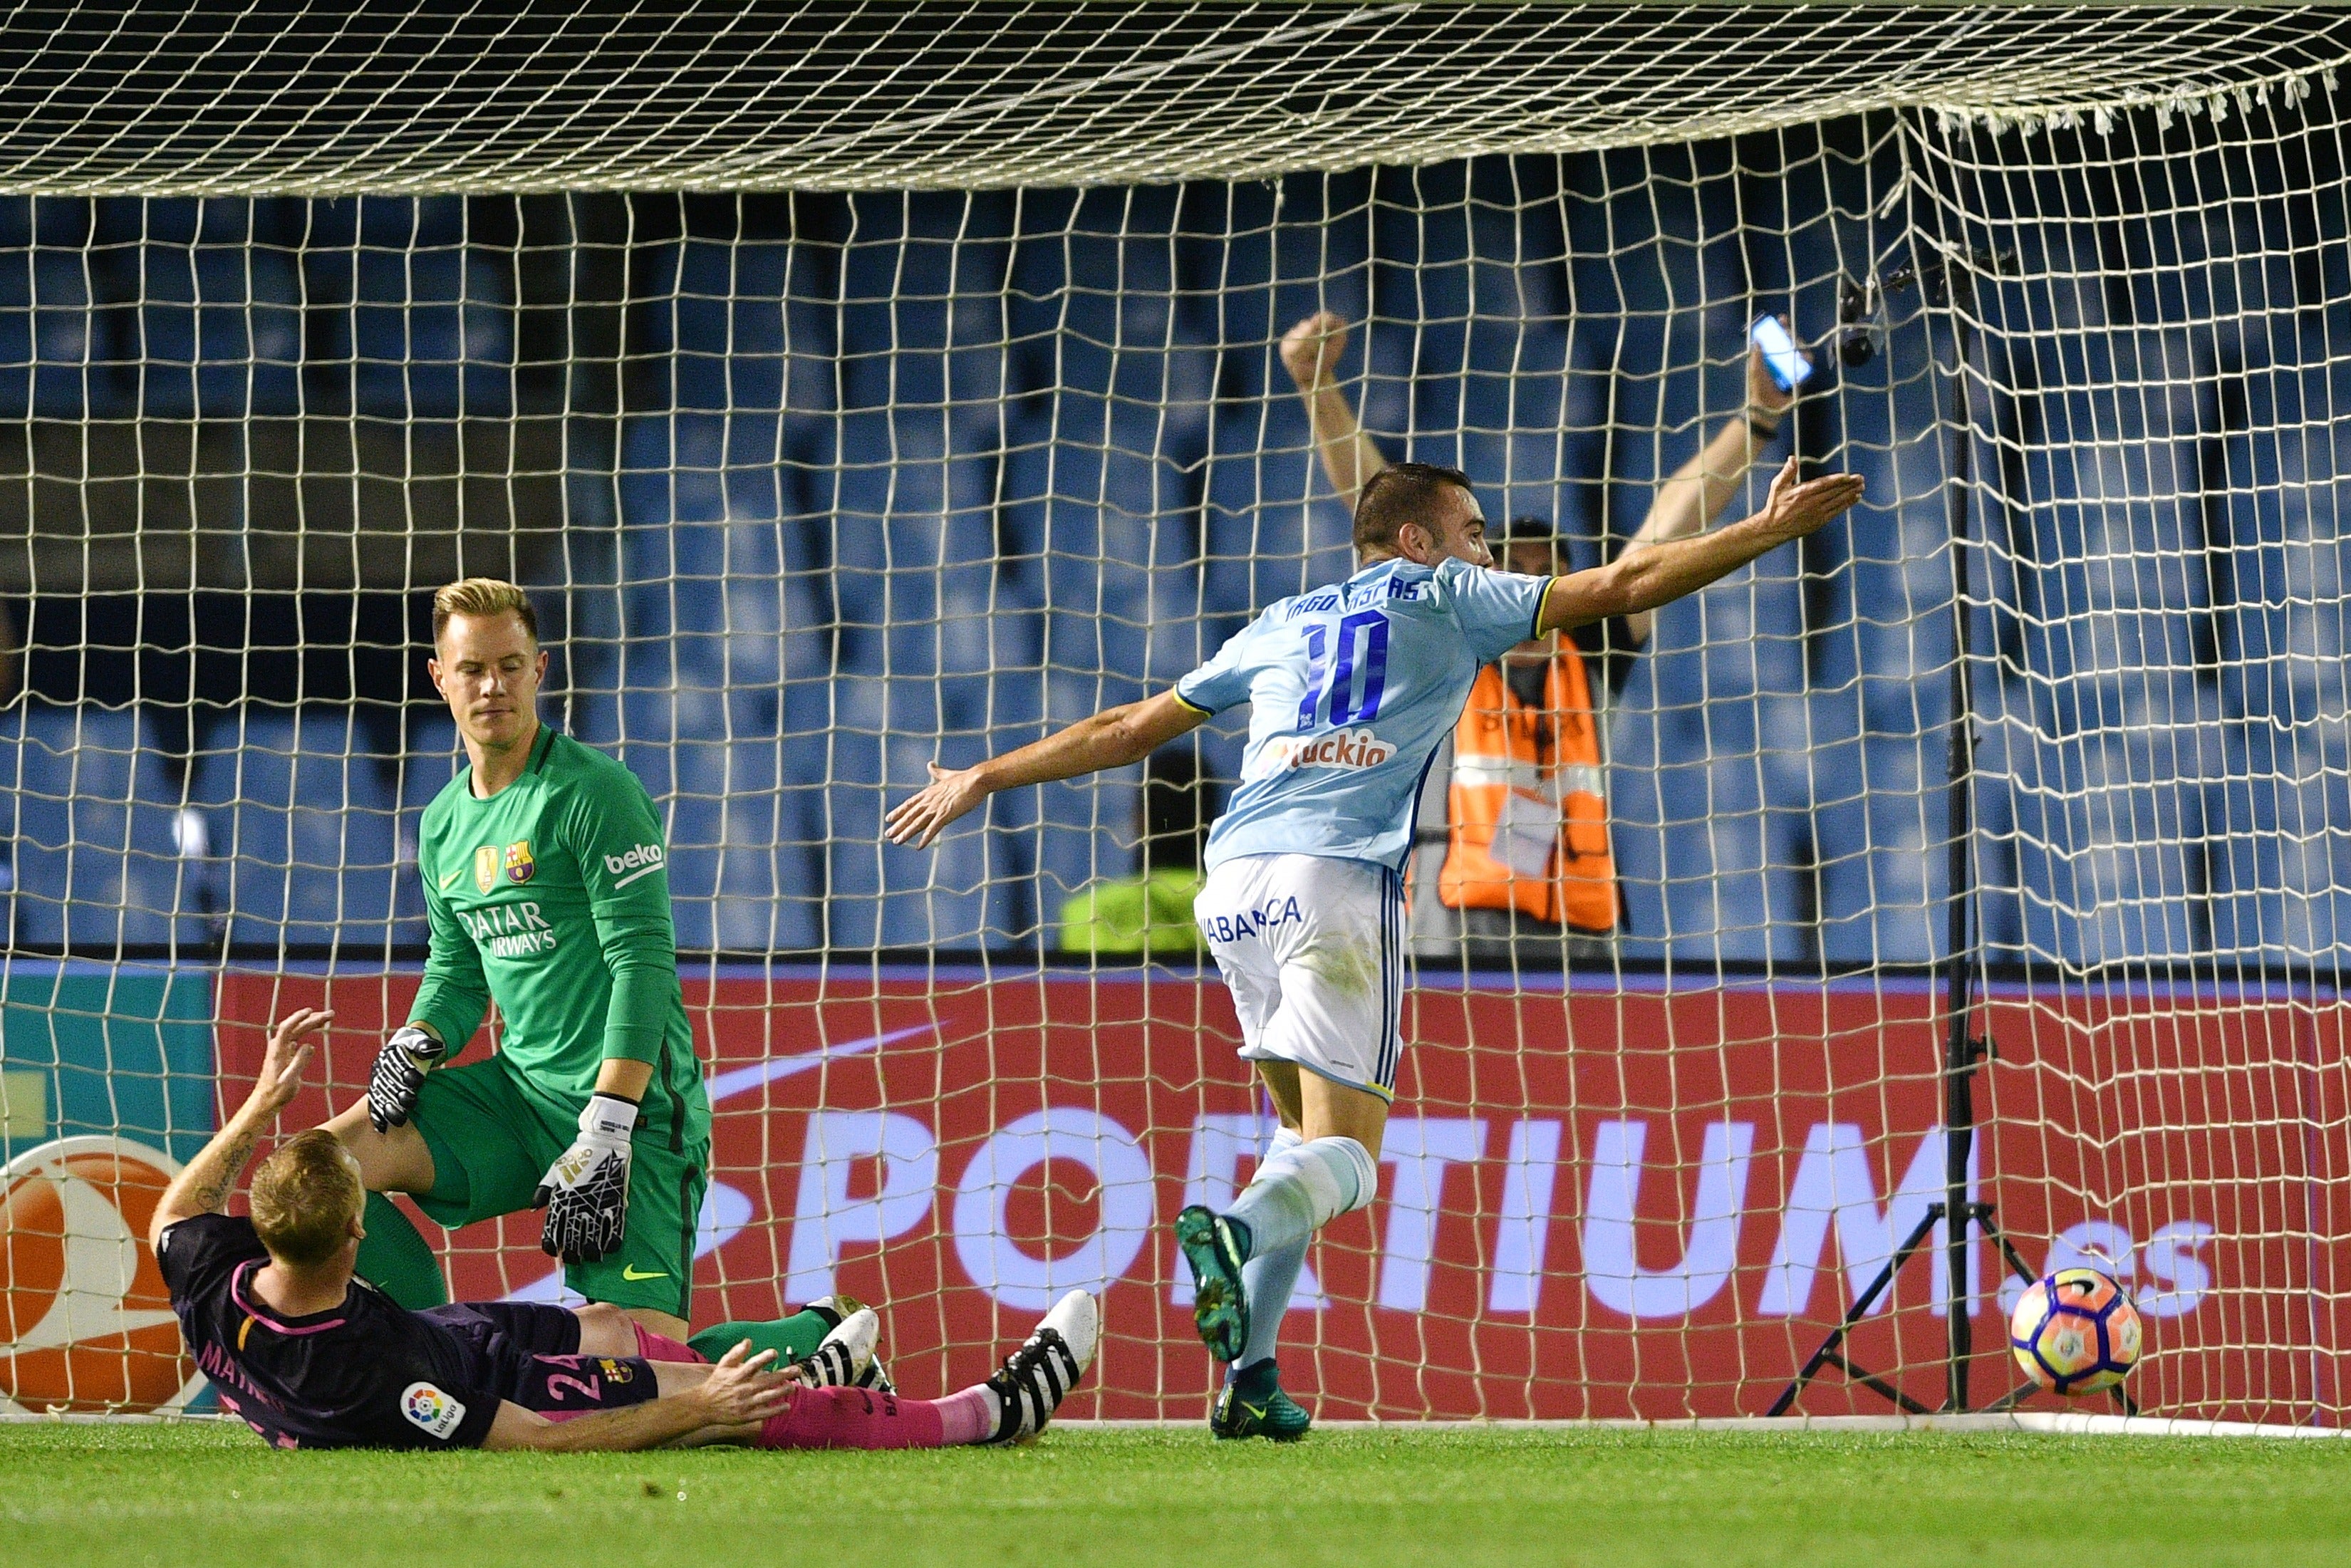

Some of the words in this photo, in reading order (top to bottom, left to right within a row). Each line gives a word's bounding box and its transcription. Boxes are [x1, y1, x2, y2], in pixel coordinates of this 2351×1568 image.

[1285, 594, 1340, 623] IAGO
[1298, 609, 1389, 732] 10
[604, 843, 663, 874] beko
[456, 902, 551, 940] QATAR
[491, 929, 556, 957] IRWAYS
[532, 1354, 602, 1401] 24
[433, 1404, 457, 1433] LaLiga
